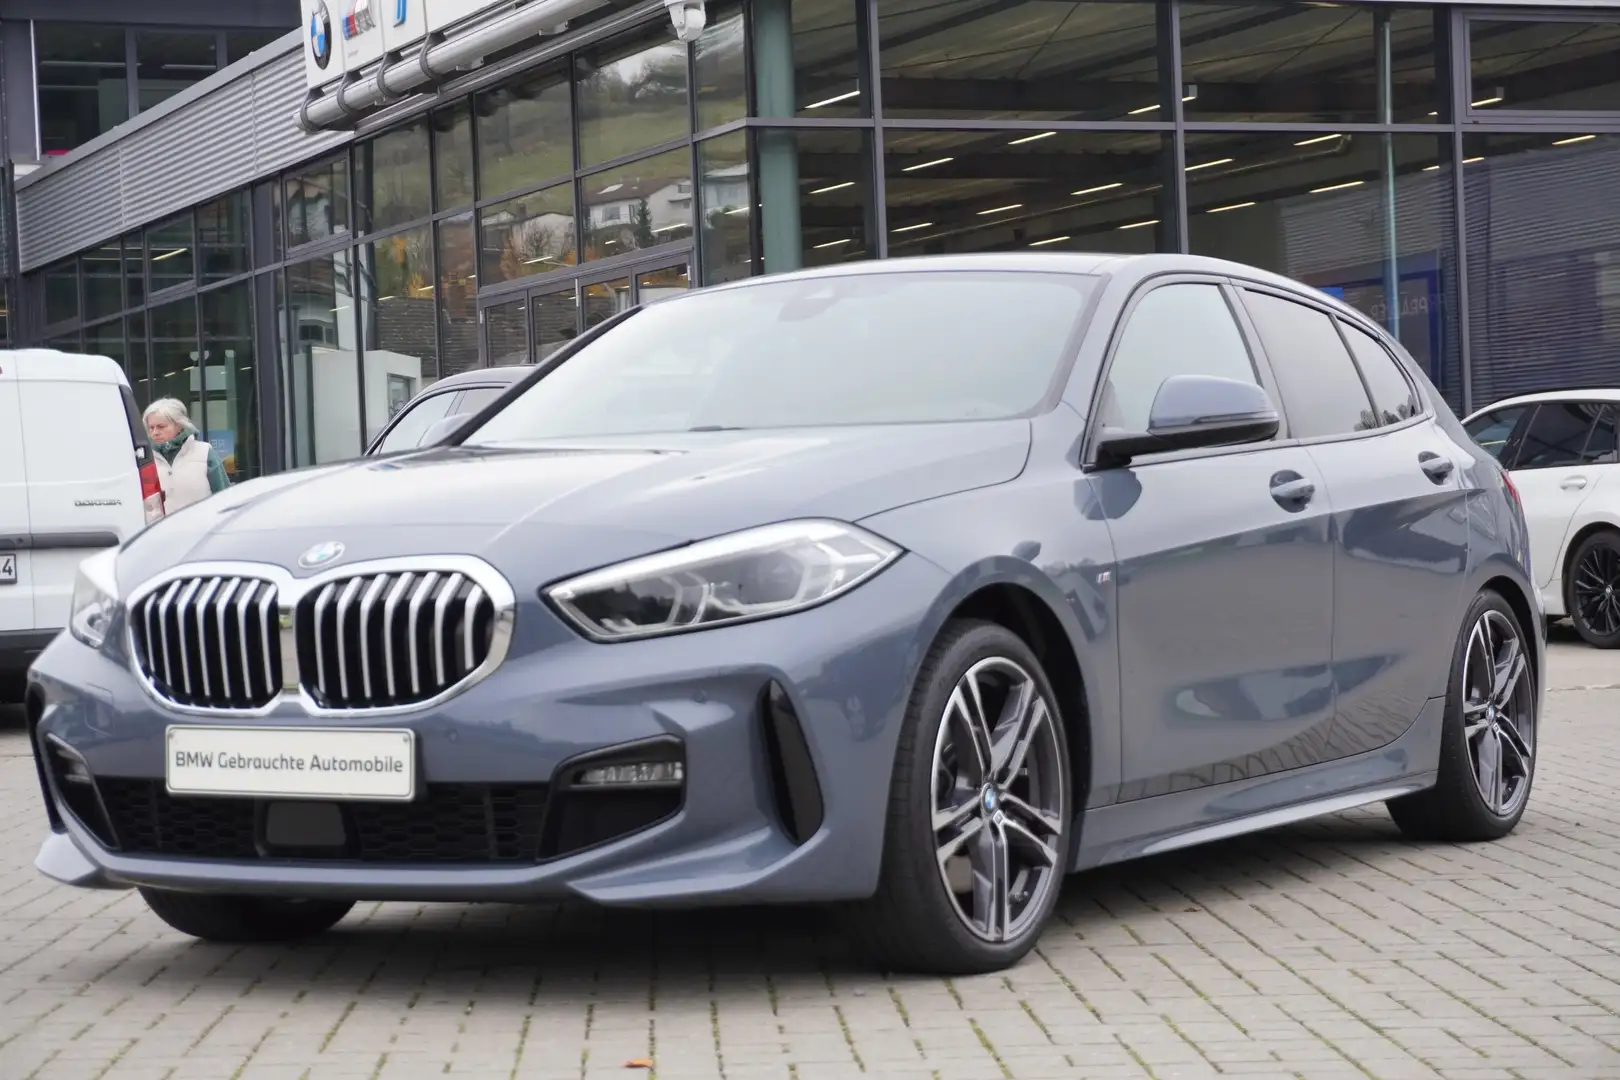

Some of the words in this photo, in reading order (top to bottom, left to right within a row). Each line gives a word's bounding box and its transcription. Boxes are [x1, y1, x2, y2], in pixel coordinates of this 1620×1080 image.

[175, 751, 214, 768] BMW
[217, 752, 305, 771] Gebrauchte
[309, 754, 404, 773] Automobile
